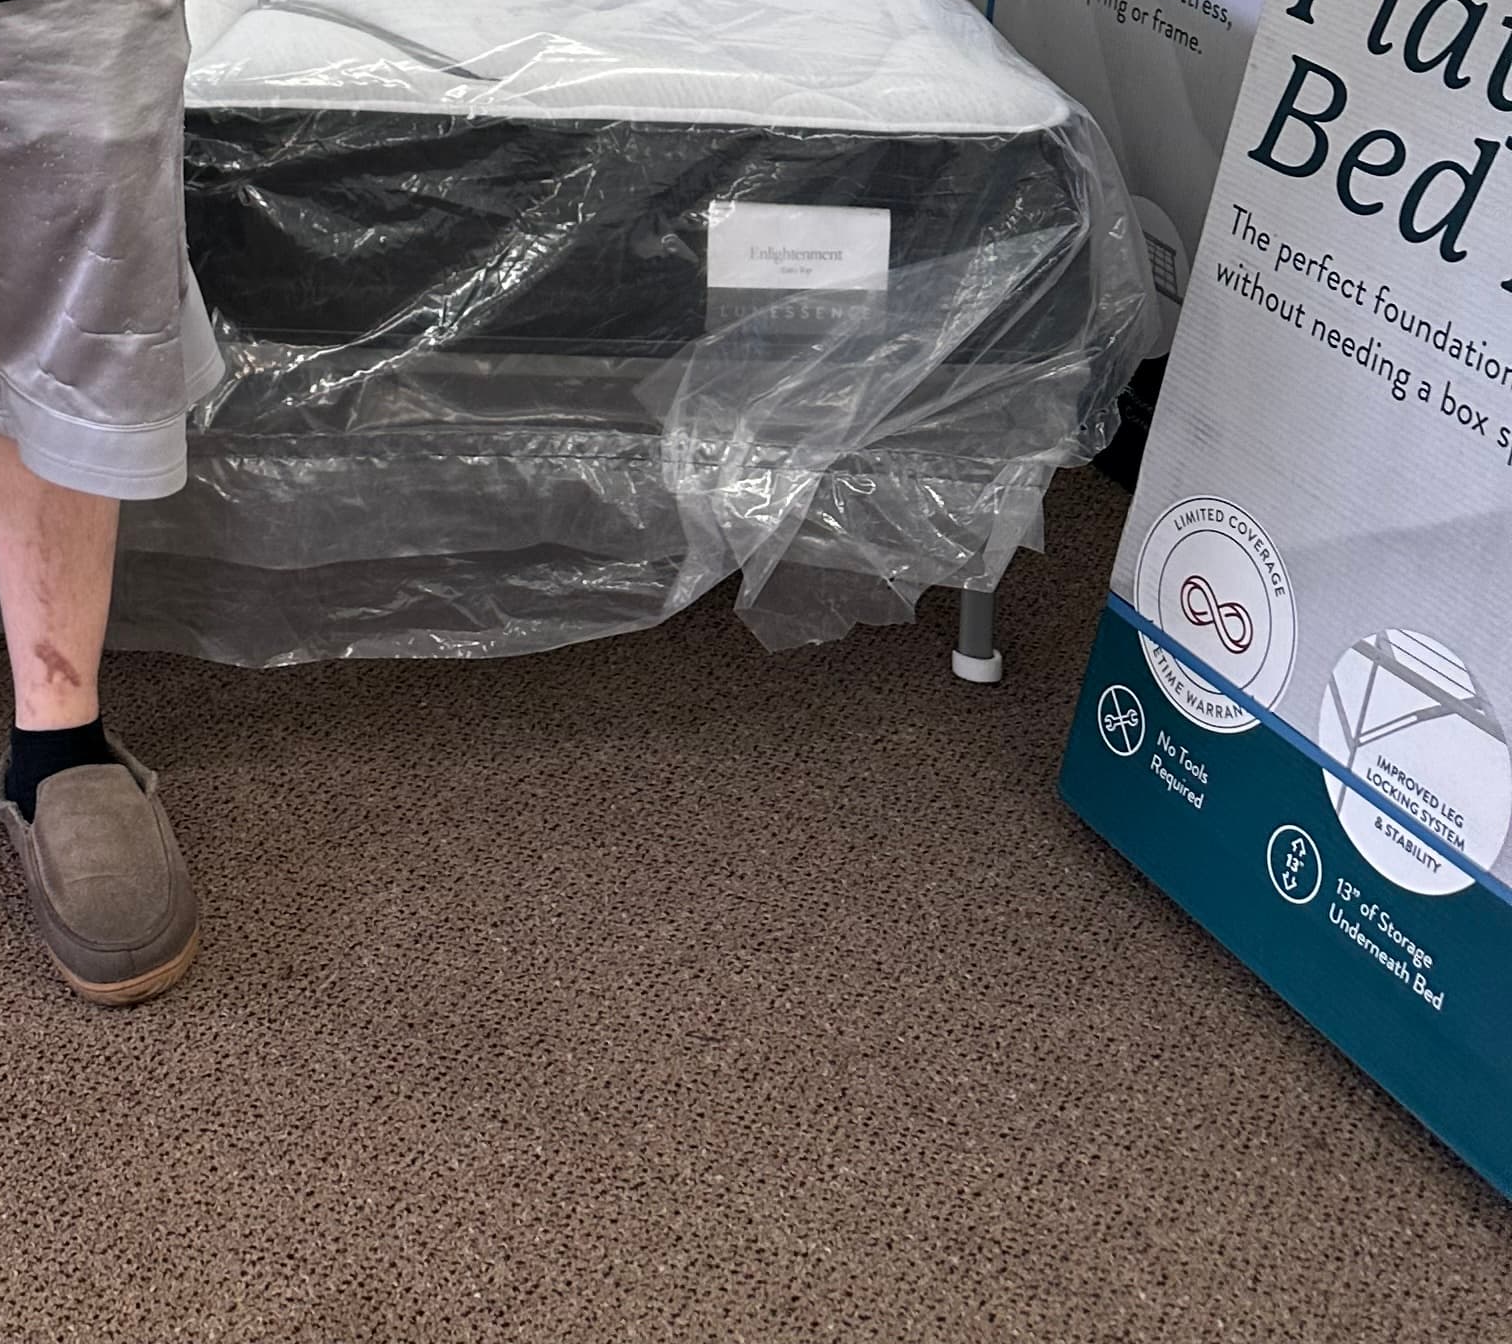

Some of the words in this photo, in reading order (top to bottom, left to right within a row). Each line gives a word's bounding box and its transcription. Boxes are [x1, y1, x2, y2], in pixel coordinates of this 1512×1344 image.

[1130, 6, 1150, 25] or
[1152, 8, 1203, 55] frame.
[1247, 54, 1501, 262] Bed
[1232, 203, 1271, 252] The
[1274, 242, 1367, 306] perfect
[1216, 263, 1306, 329] without
[1311, 318, 1411, 402] needing
[1417, 381, 1432, 403] a
[1440, 380, 1489, 436] box
[1173, 507, 1225, 532] LIMITED
[1228, 515, 1287, 598] COVERAGE
[1186, 690, 1244, 720] WARRAN
[1150, 753, 1205, 810] Required
[1156, 730, 1177, 758] No
[1180, 745, 1209, 785] Tools
[1376, 754, 1440, 809] IMPROVED
[1441, 803, 1465, 829] LEG
[1366, 767, 1420, 816] LOCKING
[1419, 809, 1465, 852] SYSTEM
[1374, 815, 1383, 831] &
[1384, 822, 1442, 874] STABILITY
[1328, 901, 1411, 985] Underneath
[1412, 972, 1446, 1011] Bed
[1359, 903, 1380, 921] of
[1377, 911, 1434, 969] Storage
